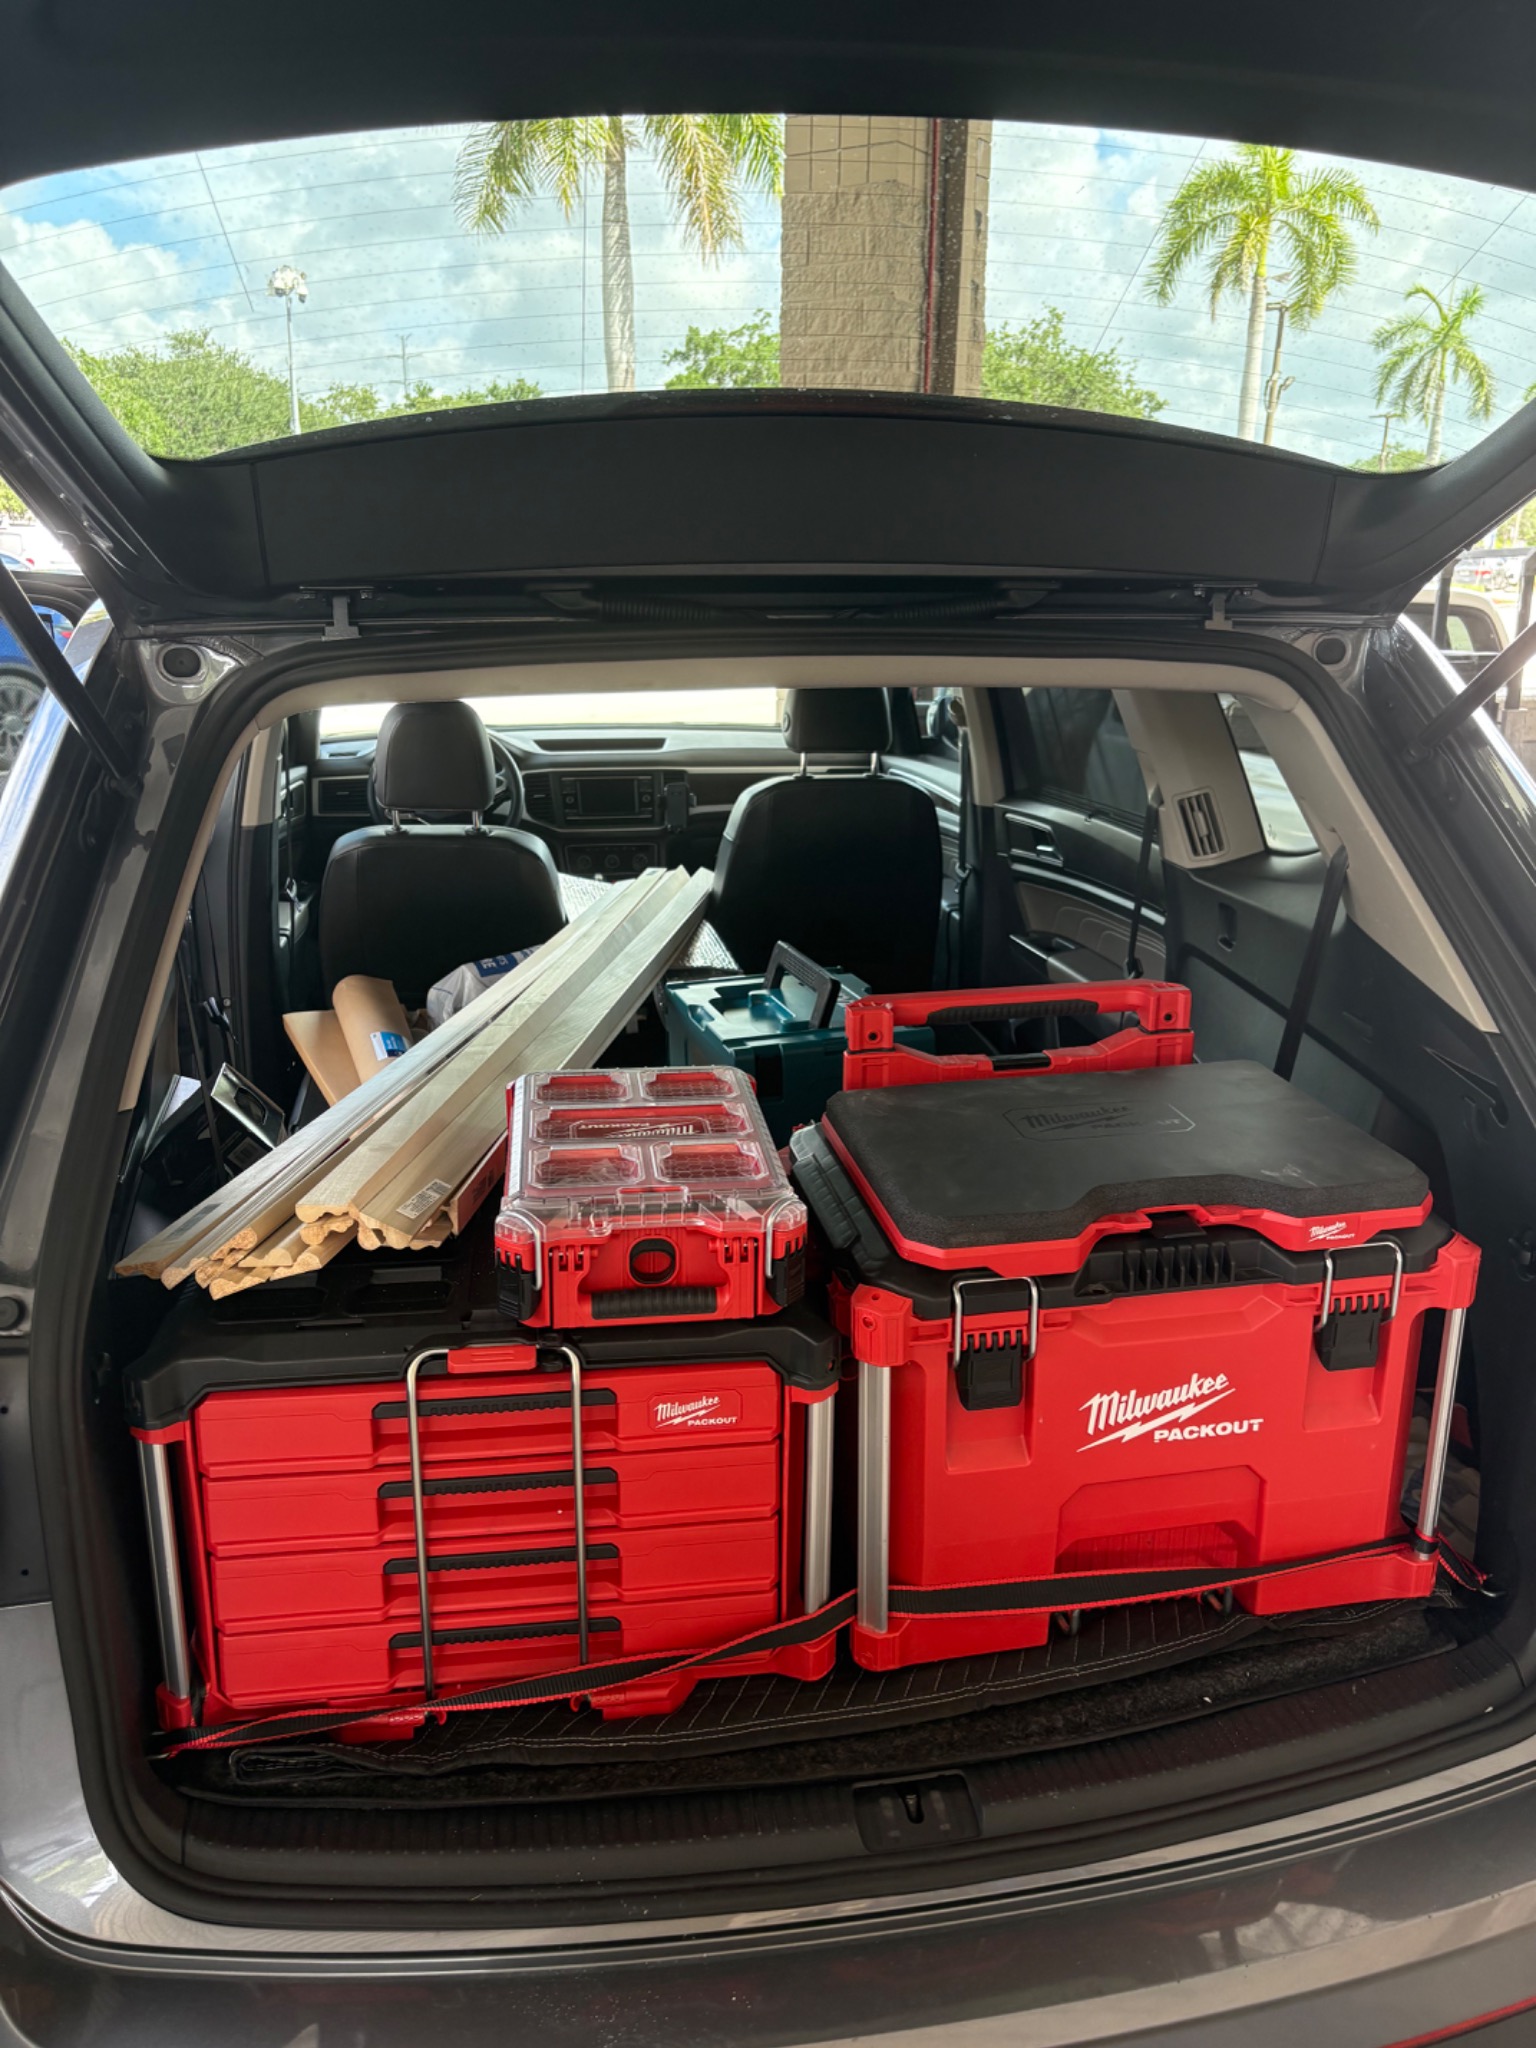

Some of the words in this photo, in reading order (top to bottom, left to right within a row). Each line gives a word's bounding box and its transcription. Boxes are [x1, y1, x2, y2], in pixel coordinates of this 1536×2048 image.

[1019, 1106, 1132, 1129] Milwaukee
[1089, 1119, 1180, 1130] PACKUT
[1309, 1221, 1347, 1238] Milwaukee
[653, 1396, 720, 1422] Milwaukee
[1079, 1373, 1230, 1436] Milwaukee
[687, 1416, 737, 1426] PACKOUT
[1154, 1418, 1264, 1443] PACKOUT
